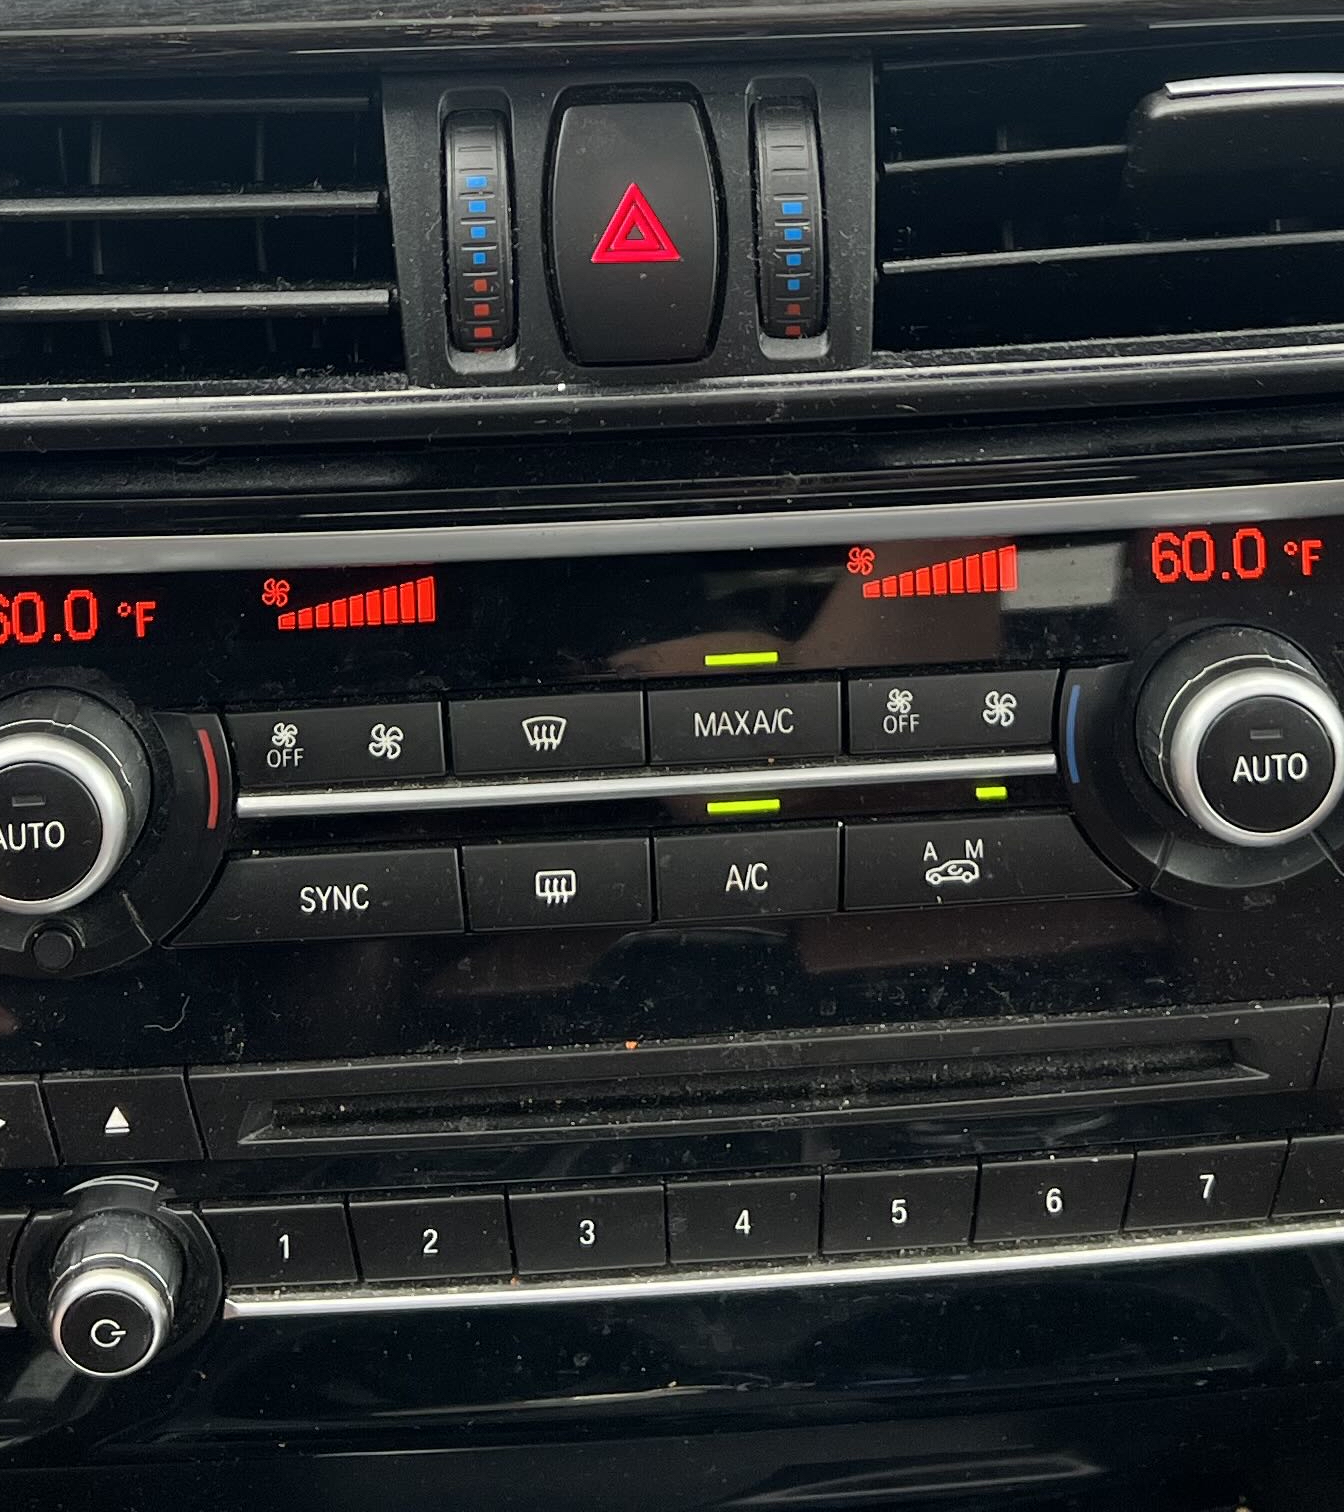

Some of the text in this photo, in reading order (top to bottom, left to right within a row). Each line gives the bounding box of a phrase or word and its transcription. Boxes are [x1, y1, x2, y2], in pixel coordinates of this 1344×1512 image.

[1152, 528, 1323, 583] 60.0 °F
[118, 601, 156, 637] °F
[883, 714, 920, 734] OFF
[267, 748, 305, 768] OFF
[1232, 753, 1309, 783] AUTO
[964, 839, 984, 858] M
[725, 862, 769, 892] A/C
[300, 883, 370, 913] SYNC
[1199, 1175, 1215, 1199] 7
[891, 1199, 908, 1225] 5
[1045, 1188, 1063, 1213] 6
[579, 1220, 596, 1245] 3
[734, 1210, 752, 1235] 4
[278, 1234, 291, 1260] 1
[422, 1229, 439, 1254] 2
